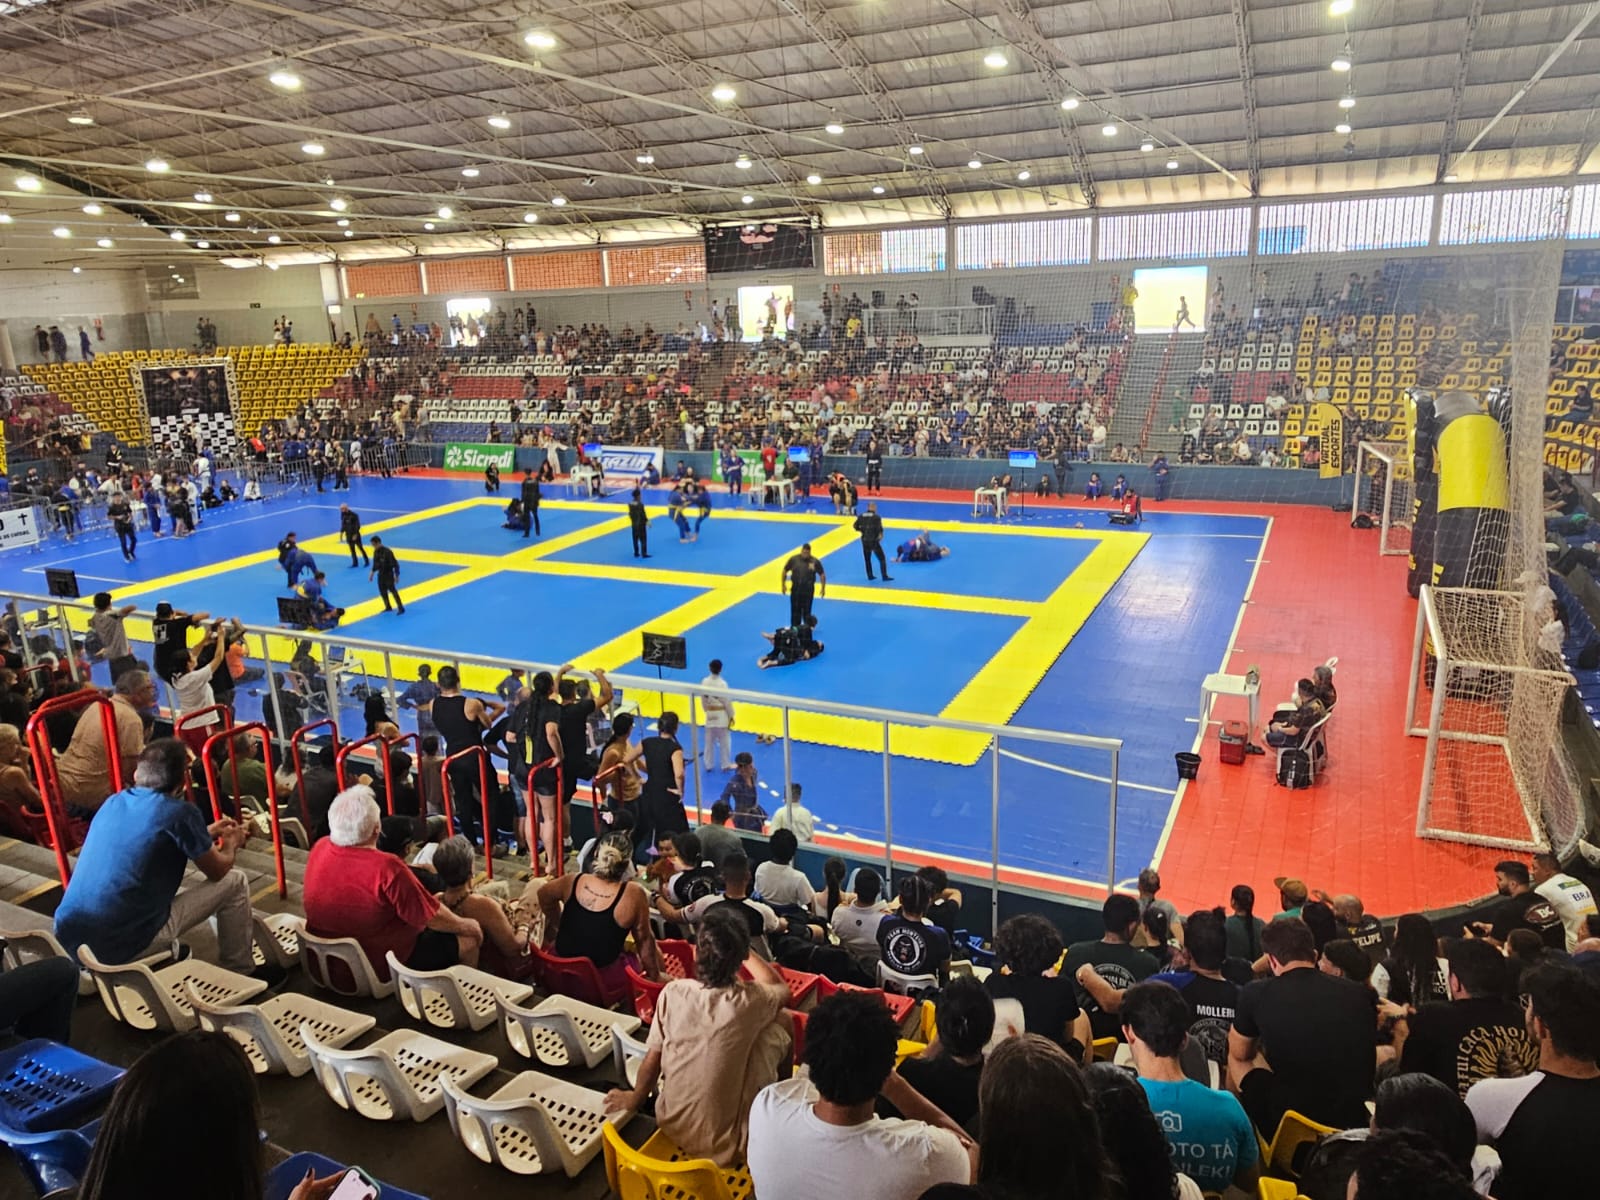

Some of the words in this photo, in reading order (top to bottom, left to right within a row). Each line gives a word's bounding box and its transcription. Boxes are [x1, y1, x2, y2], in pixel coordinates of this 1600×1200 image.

[462, 448, 514, 468] Sicredi
[1320, 425, 1330, 465] VIRTUAL
[1331, 419, 1340, 469] ESPORTES
[1167, 1141, 1206, 1159] OTO
